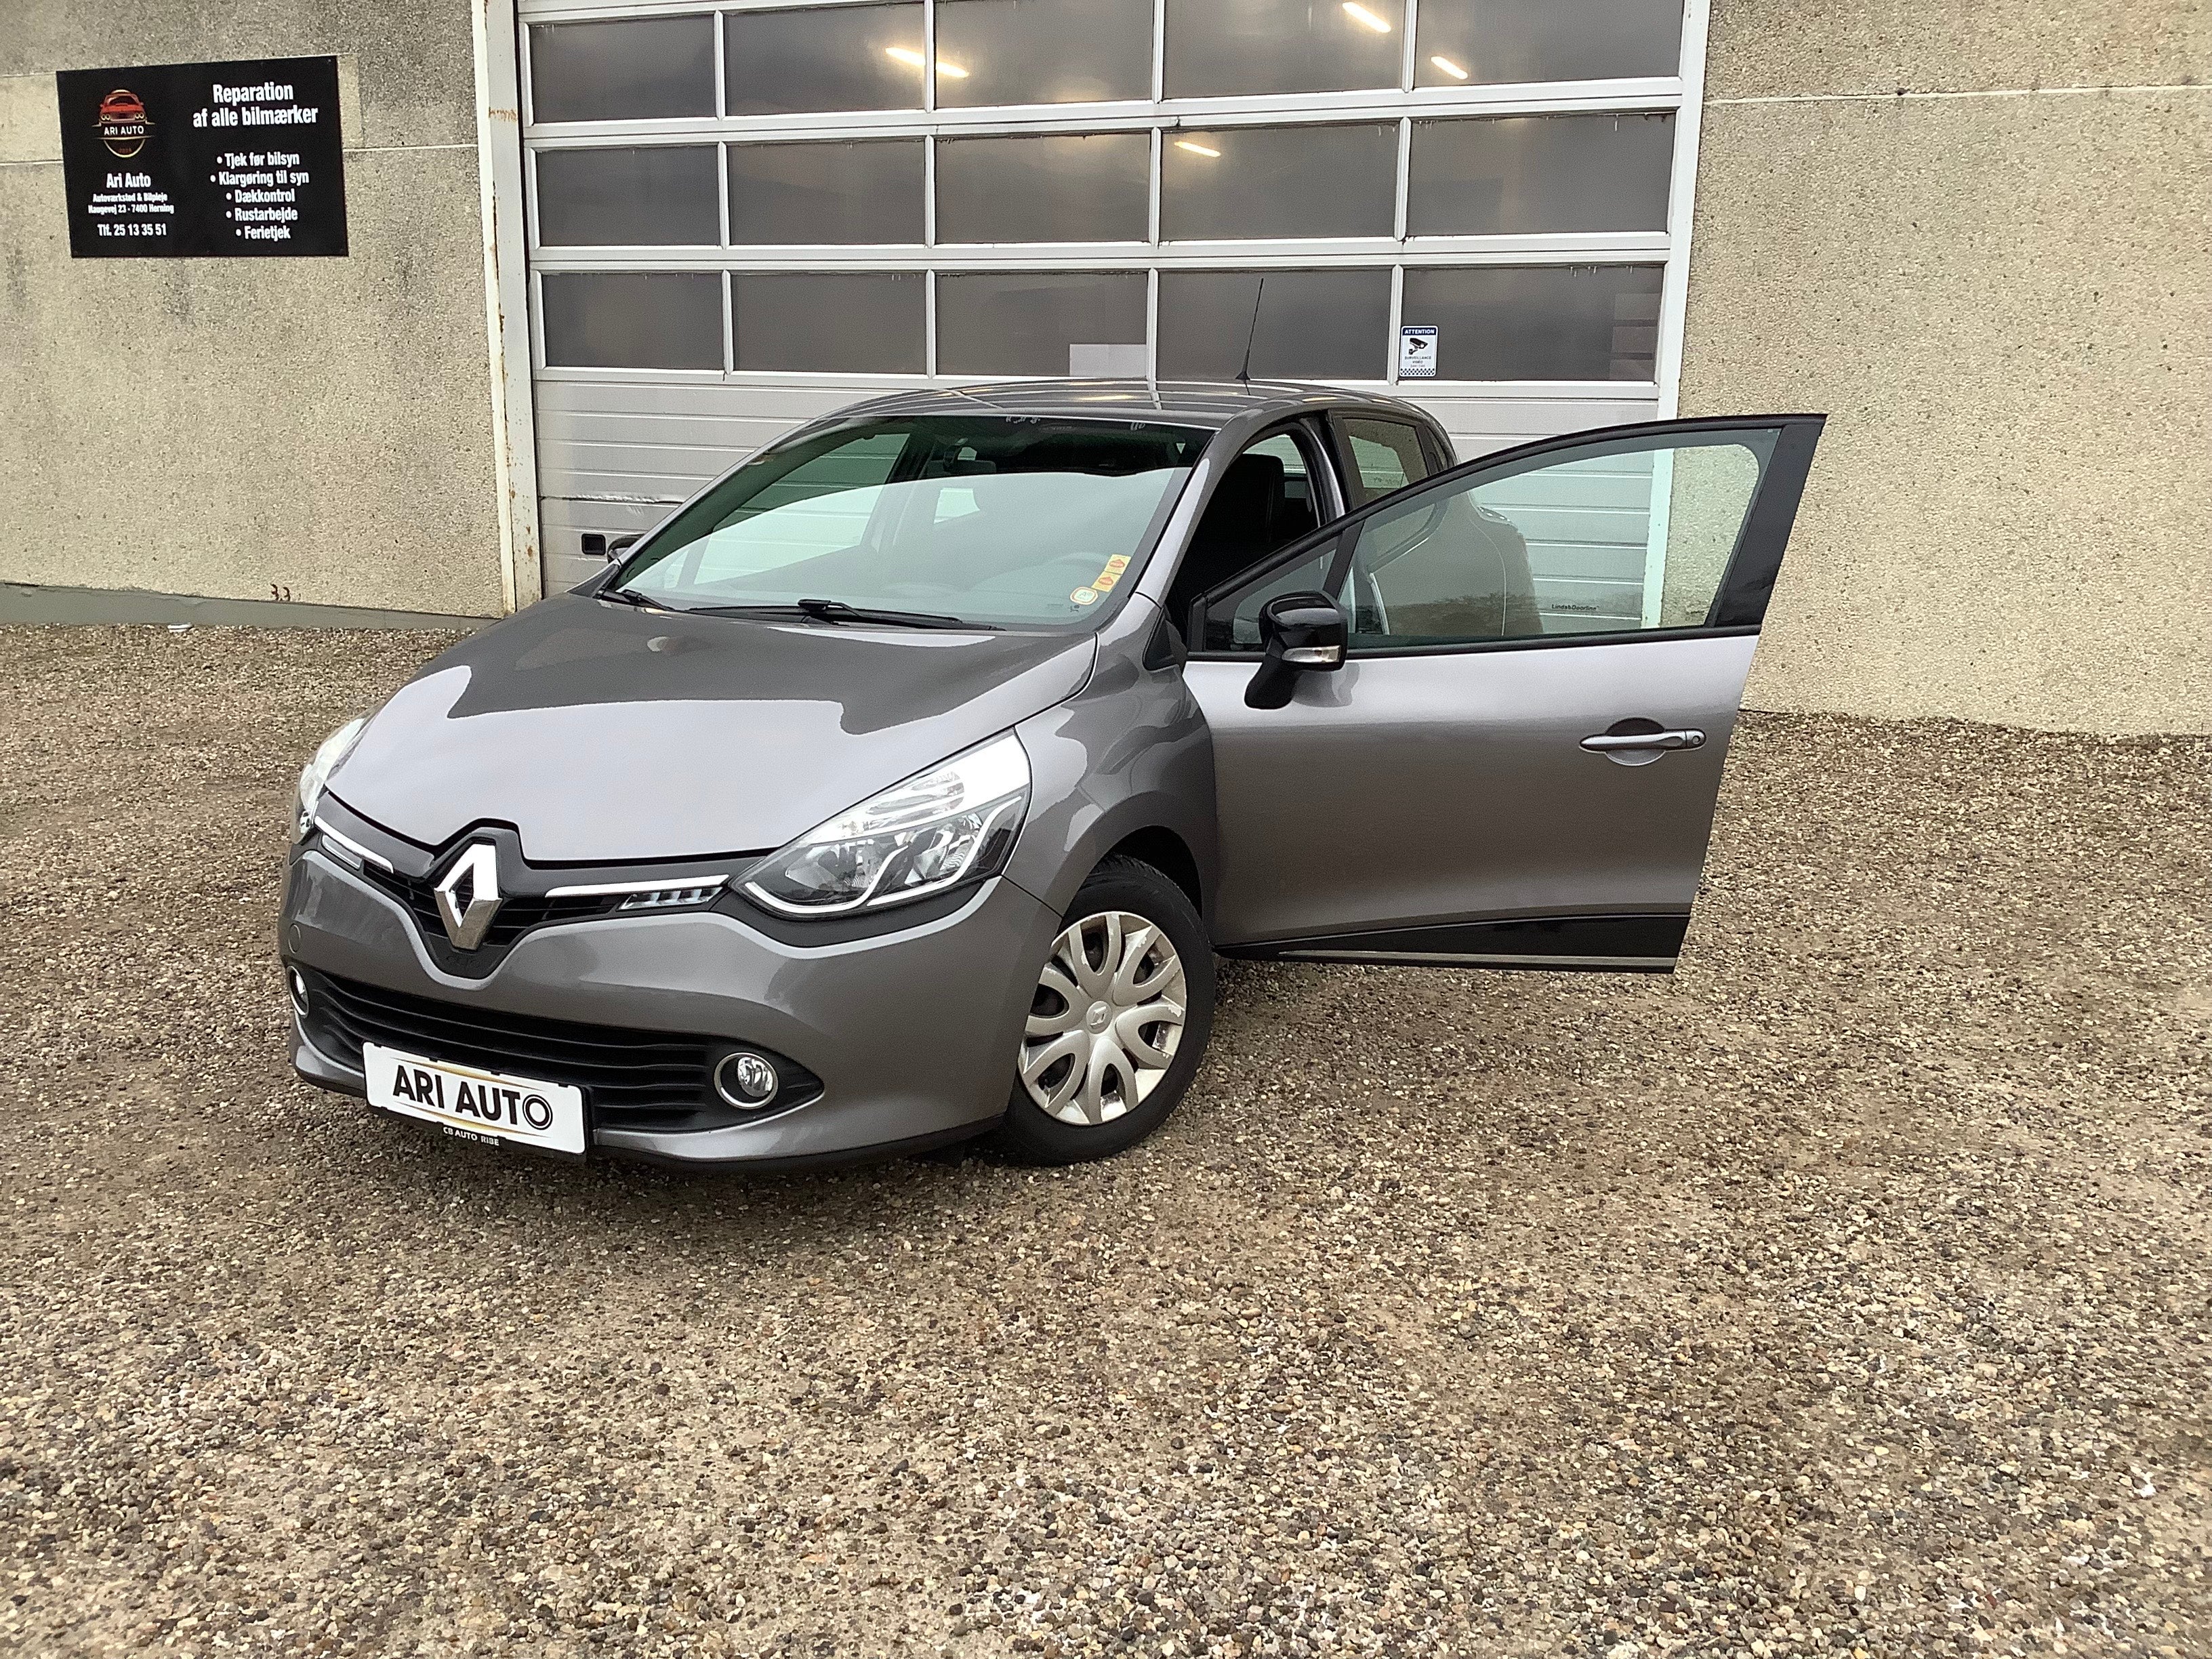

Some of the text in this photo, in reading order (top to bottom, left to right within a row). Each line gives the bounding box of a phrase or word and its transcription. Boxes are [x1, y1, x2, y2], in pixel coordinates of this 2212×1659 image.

[212, 81, 293, 106] Reparation
[192, 104, 319, 127] af alle bilmærker
[104, 125, 144, 136] ARI AUTO
[224, 151, 300, 169] Tjek før bilsyn
[106, 172, 151, 188] Ari Auto
[218, 169, 310, 188] Klargøring til syn
[137, 192, 143, 202] &
[234, 188, 295, 203] Dækkontrol
[117, 204, 127, 213] 23
[131, 203, 148, 213] 7400
[148, 203, 175, 215] Herning
[234, 207, 298, 223] Rustarbejde
[113, 224, 126, 237] 25
[127, 223, 140, 236] 13
[141, 223, 154, 236] 35
[155, 223, 167, 236] 51
[244, 225, 291, 242] Ferietjek
[392, 1065, 554, 1131] ARI AUTO
[443, 1126, 500, 1147] CB AUTO RIBE
